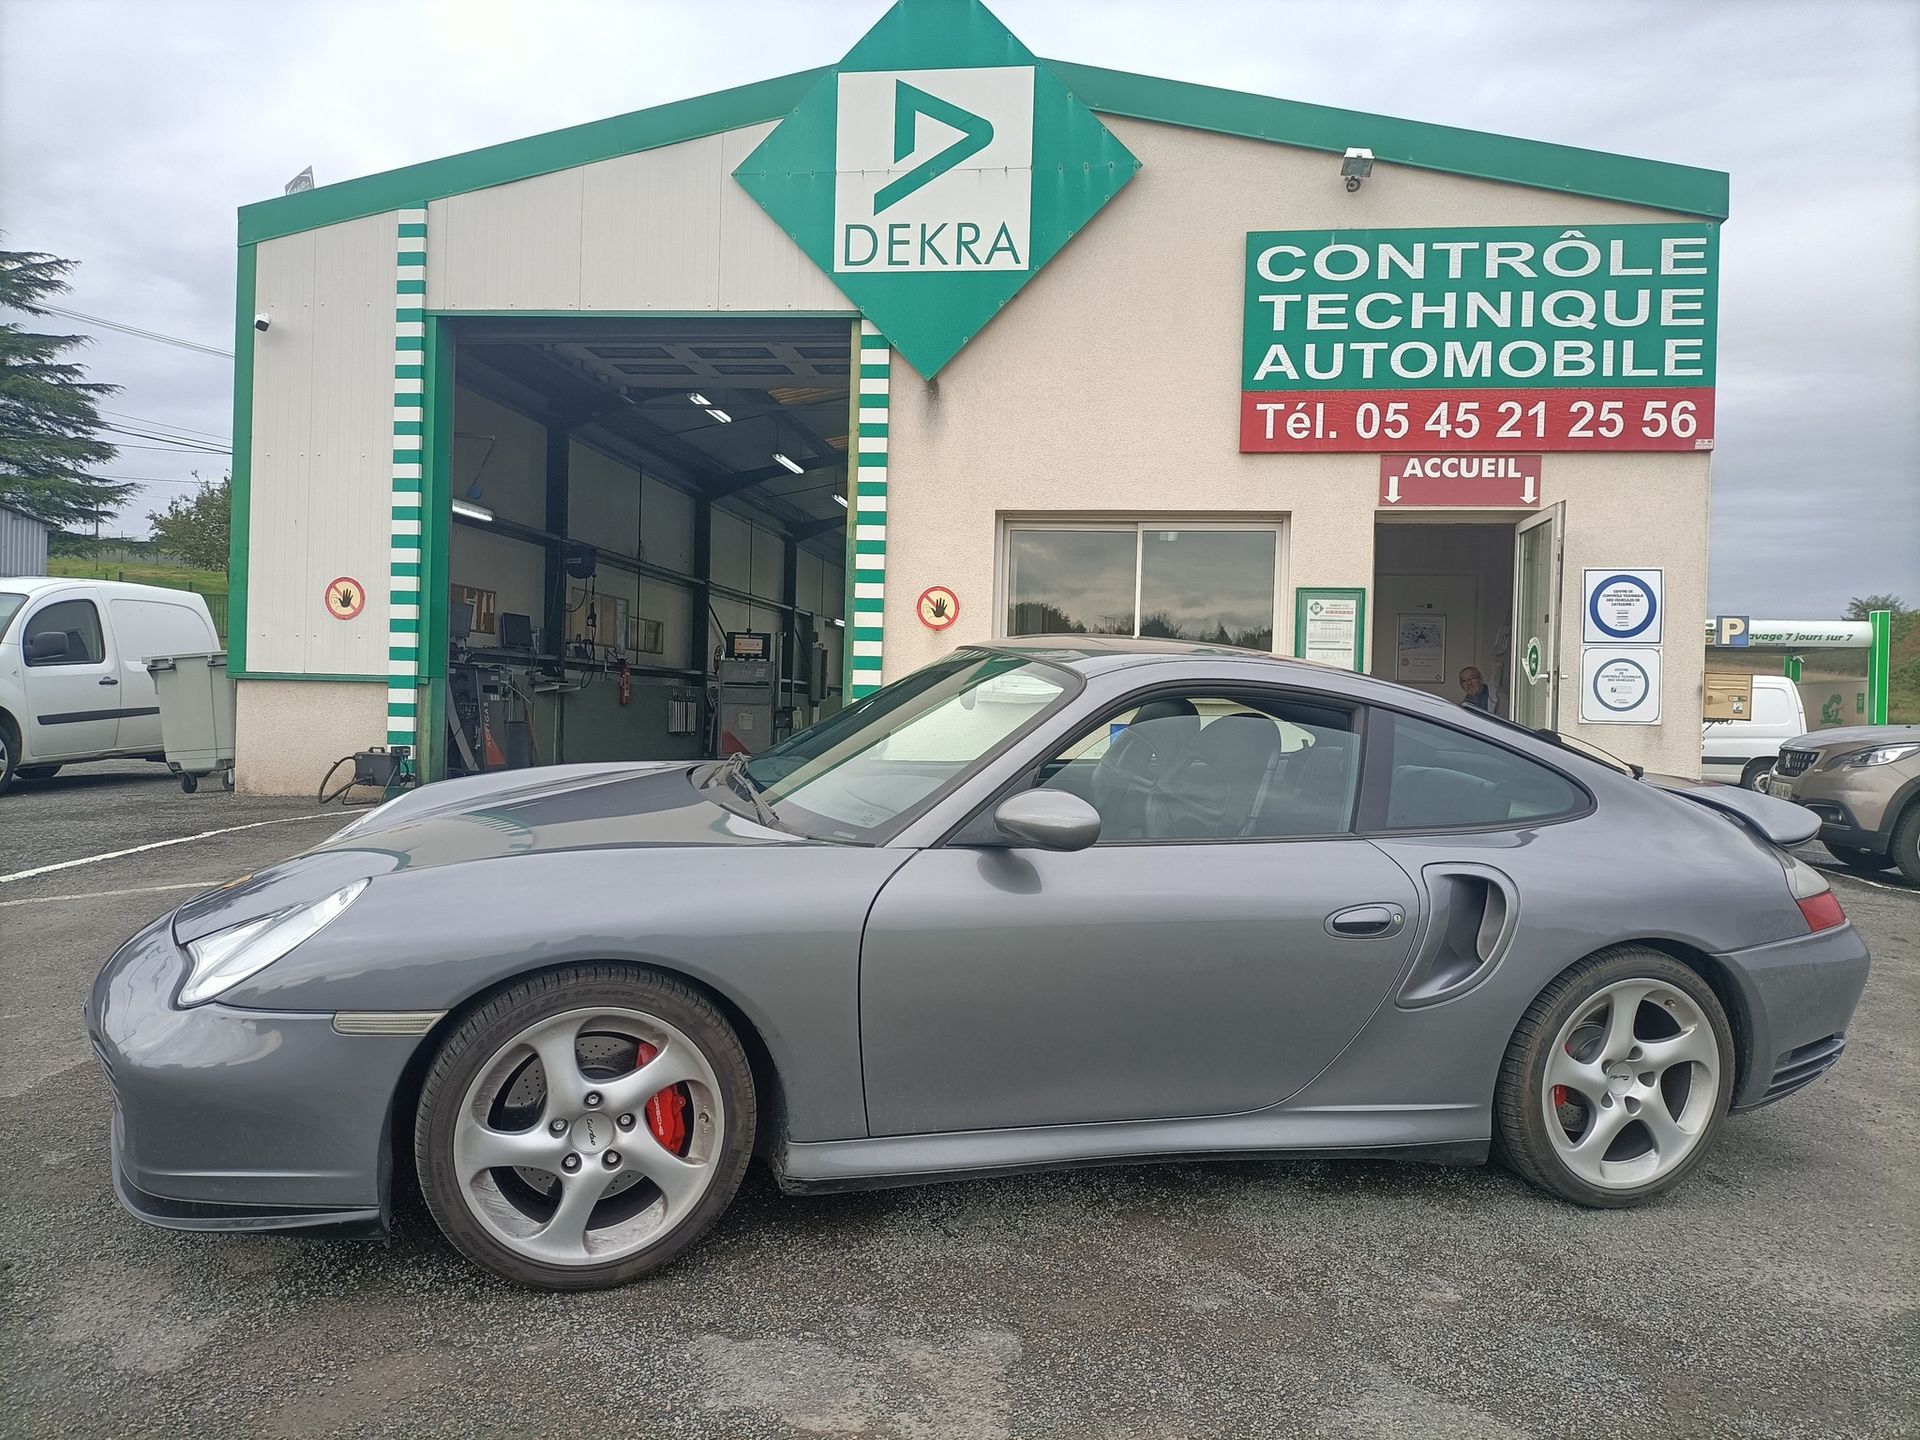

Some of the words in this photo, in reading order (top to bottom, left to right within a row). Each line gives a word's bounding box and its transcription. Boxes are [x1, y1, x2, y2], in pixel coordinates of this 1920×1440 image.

[844, 221, 1022, 267] DEKRA
[1256, 230, 1707, 283] CONTRÔLE
[1258, 288, 1705, 331] TECHNIQUE
[1253, 338, 1703, 381] AUTOMOBILE
[1256, 402, 1337, 439] Tél.
[1355, 402, 1410, 439] 05
[1424, 401, 1480, 439] 45
[1495, 400, 1546, 438] 21
[1567, 400, 1625, 438] 25
[1641, 400, 1697, 438] 56
[1402, 457, 1522, 478] ACCUEIL
[1721, 617, 1746, 645] P
[1749, 633, 1784, 641] avage
[1794, 633, 1823, 641] jours
[587, 1118, 596, 1146] turbo
[654, 1094, 664, 1135] ORSCHE
